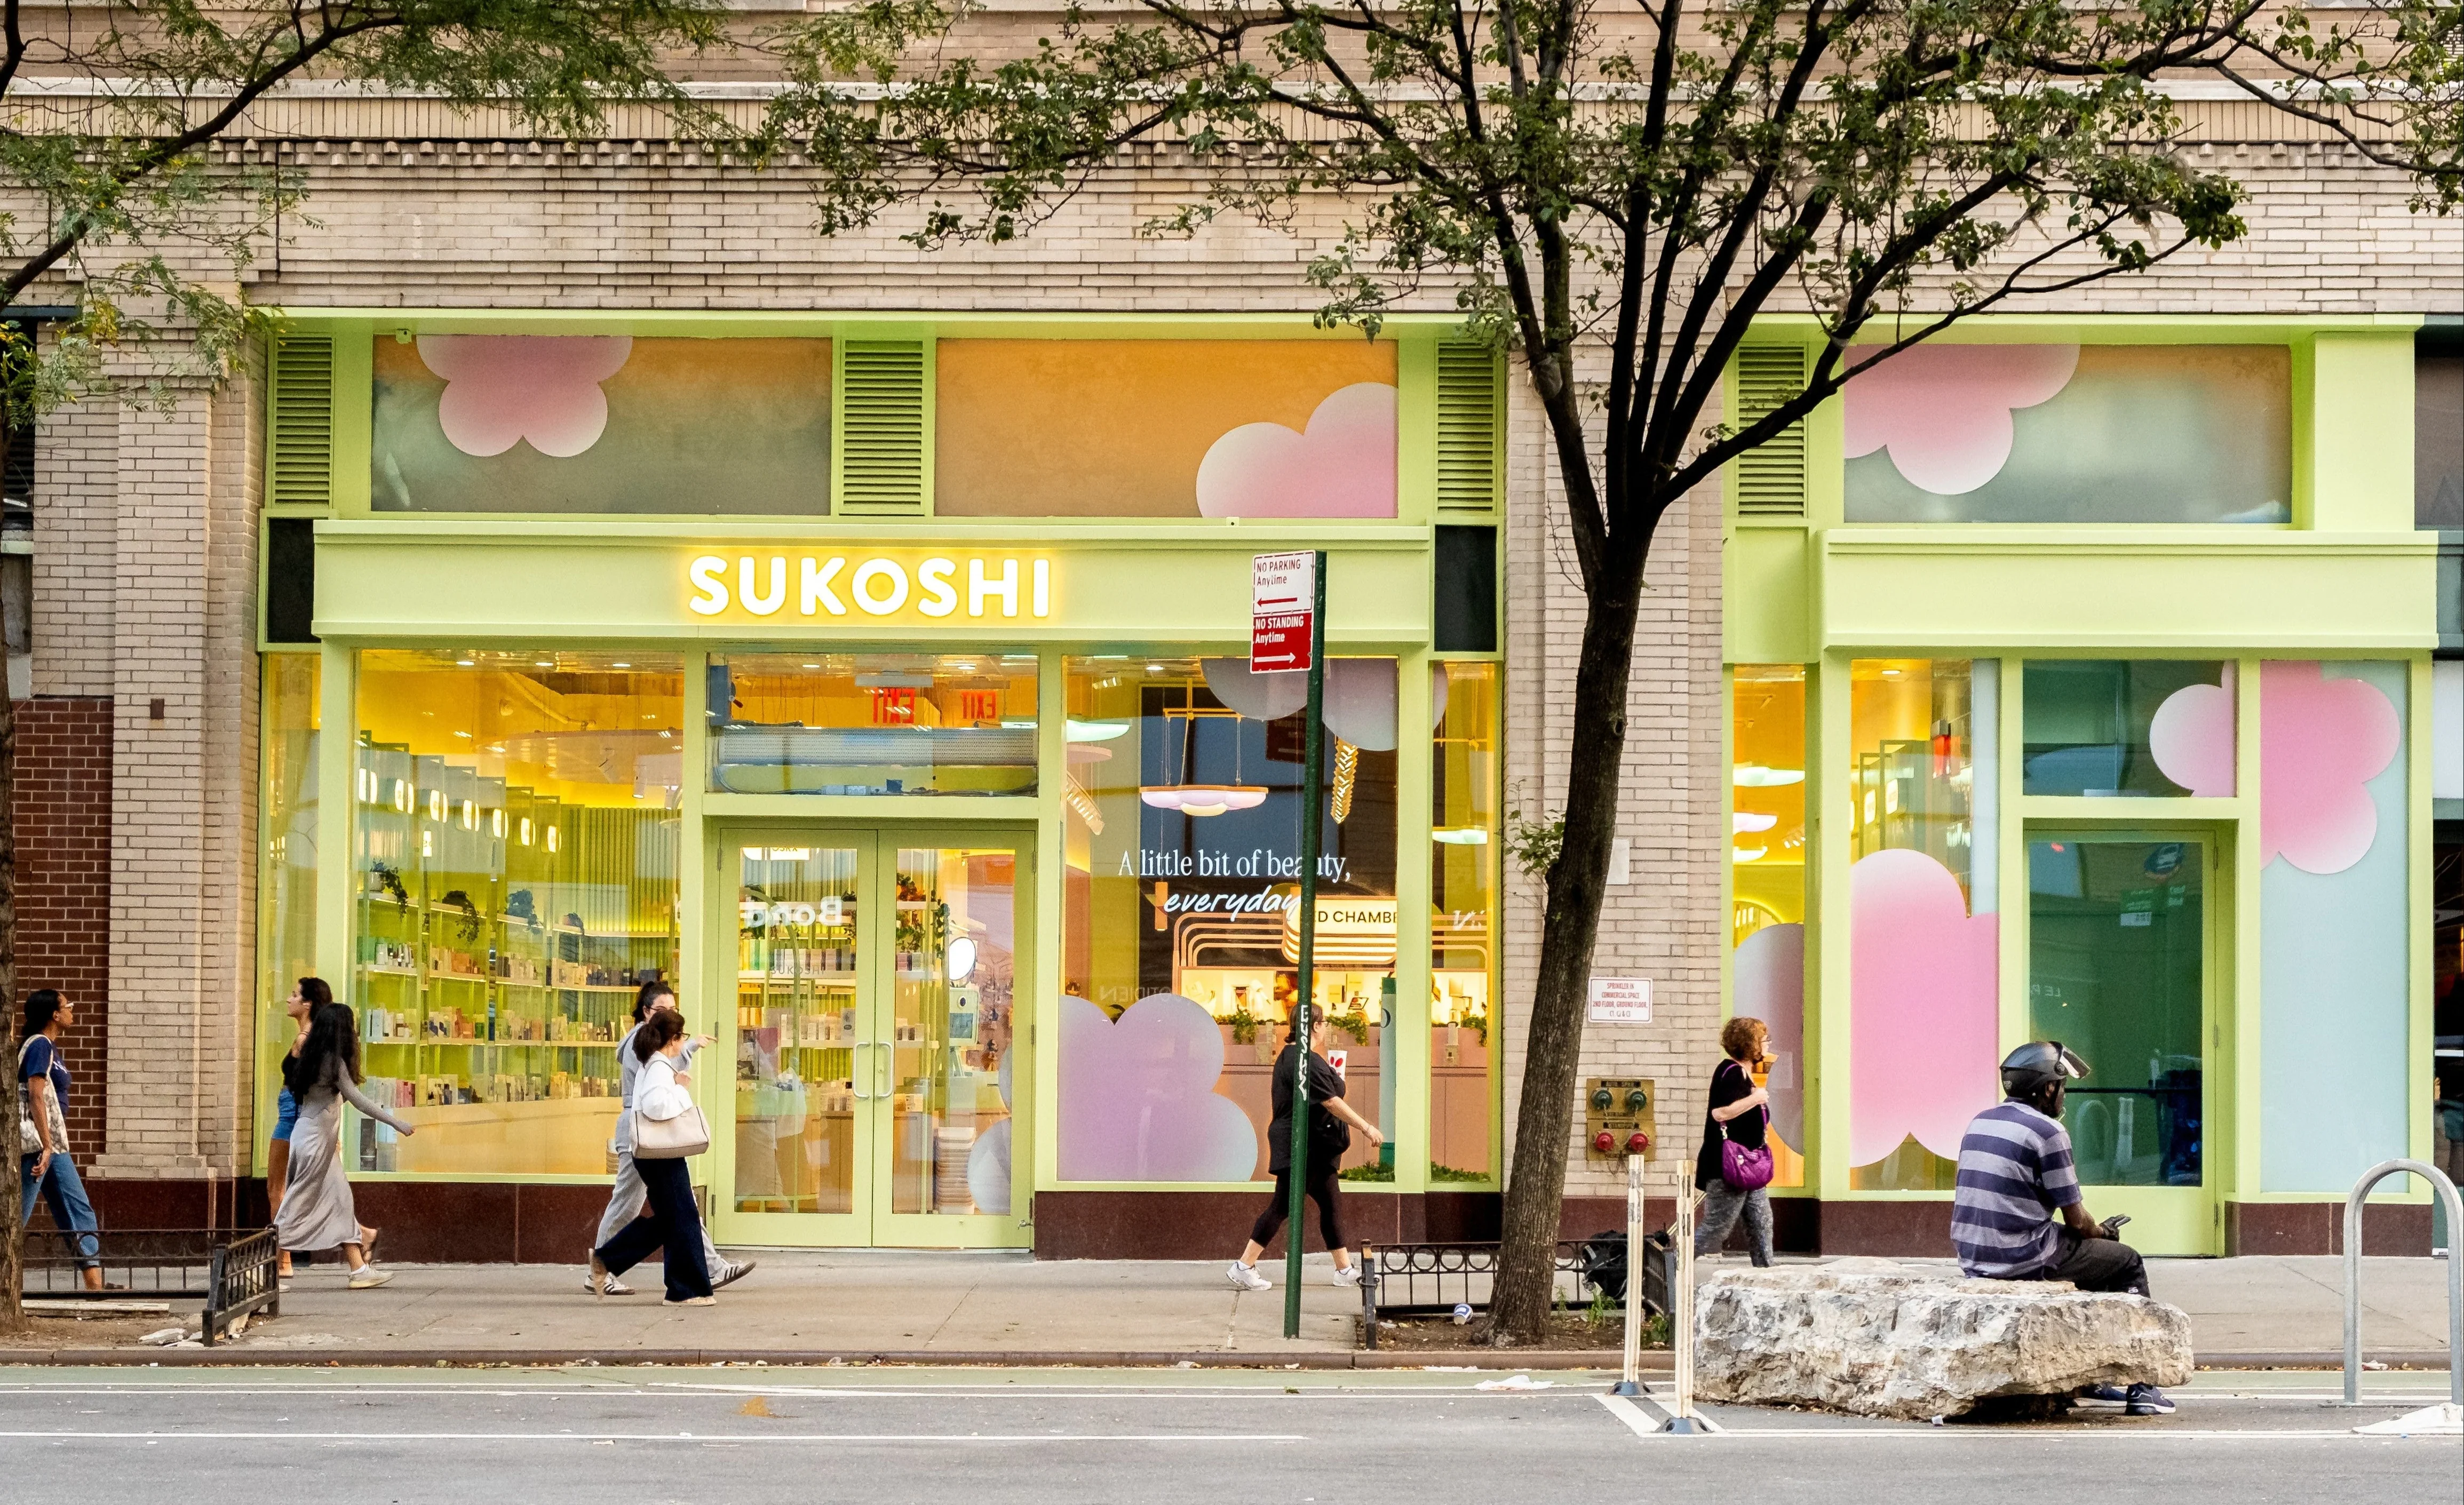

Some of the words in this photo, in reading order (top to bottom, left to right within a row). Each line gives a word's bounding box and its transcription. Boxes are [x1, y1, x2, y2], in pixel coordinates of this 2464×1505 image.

[1257, 562, 1267, 573] NO
[1269, 559, 1301, 571] PARKING
[689, 555, 1050, 617] SUKOSHI
[1257, 575, 1287, 587] Anytime
[1255, 618, 1266, 630] NO
[1267, 615, 1304, 630] STANDING
[1254, 632, 1285, 646] Anytime
[1118, 850, 1134, 875] A
[1140, 849, 1193, 875] little
[1198, 850, 1230, 875] bit
[1237, 849, 1261, 875] of
[1163, 885, 1301, 921] everyday
